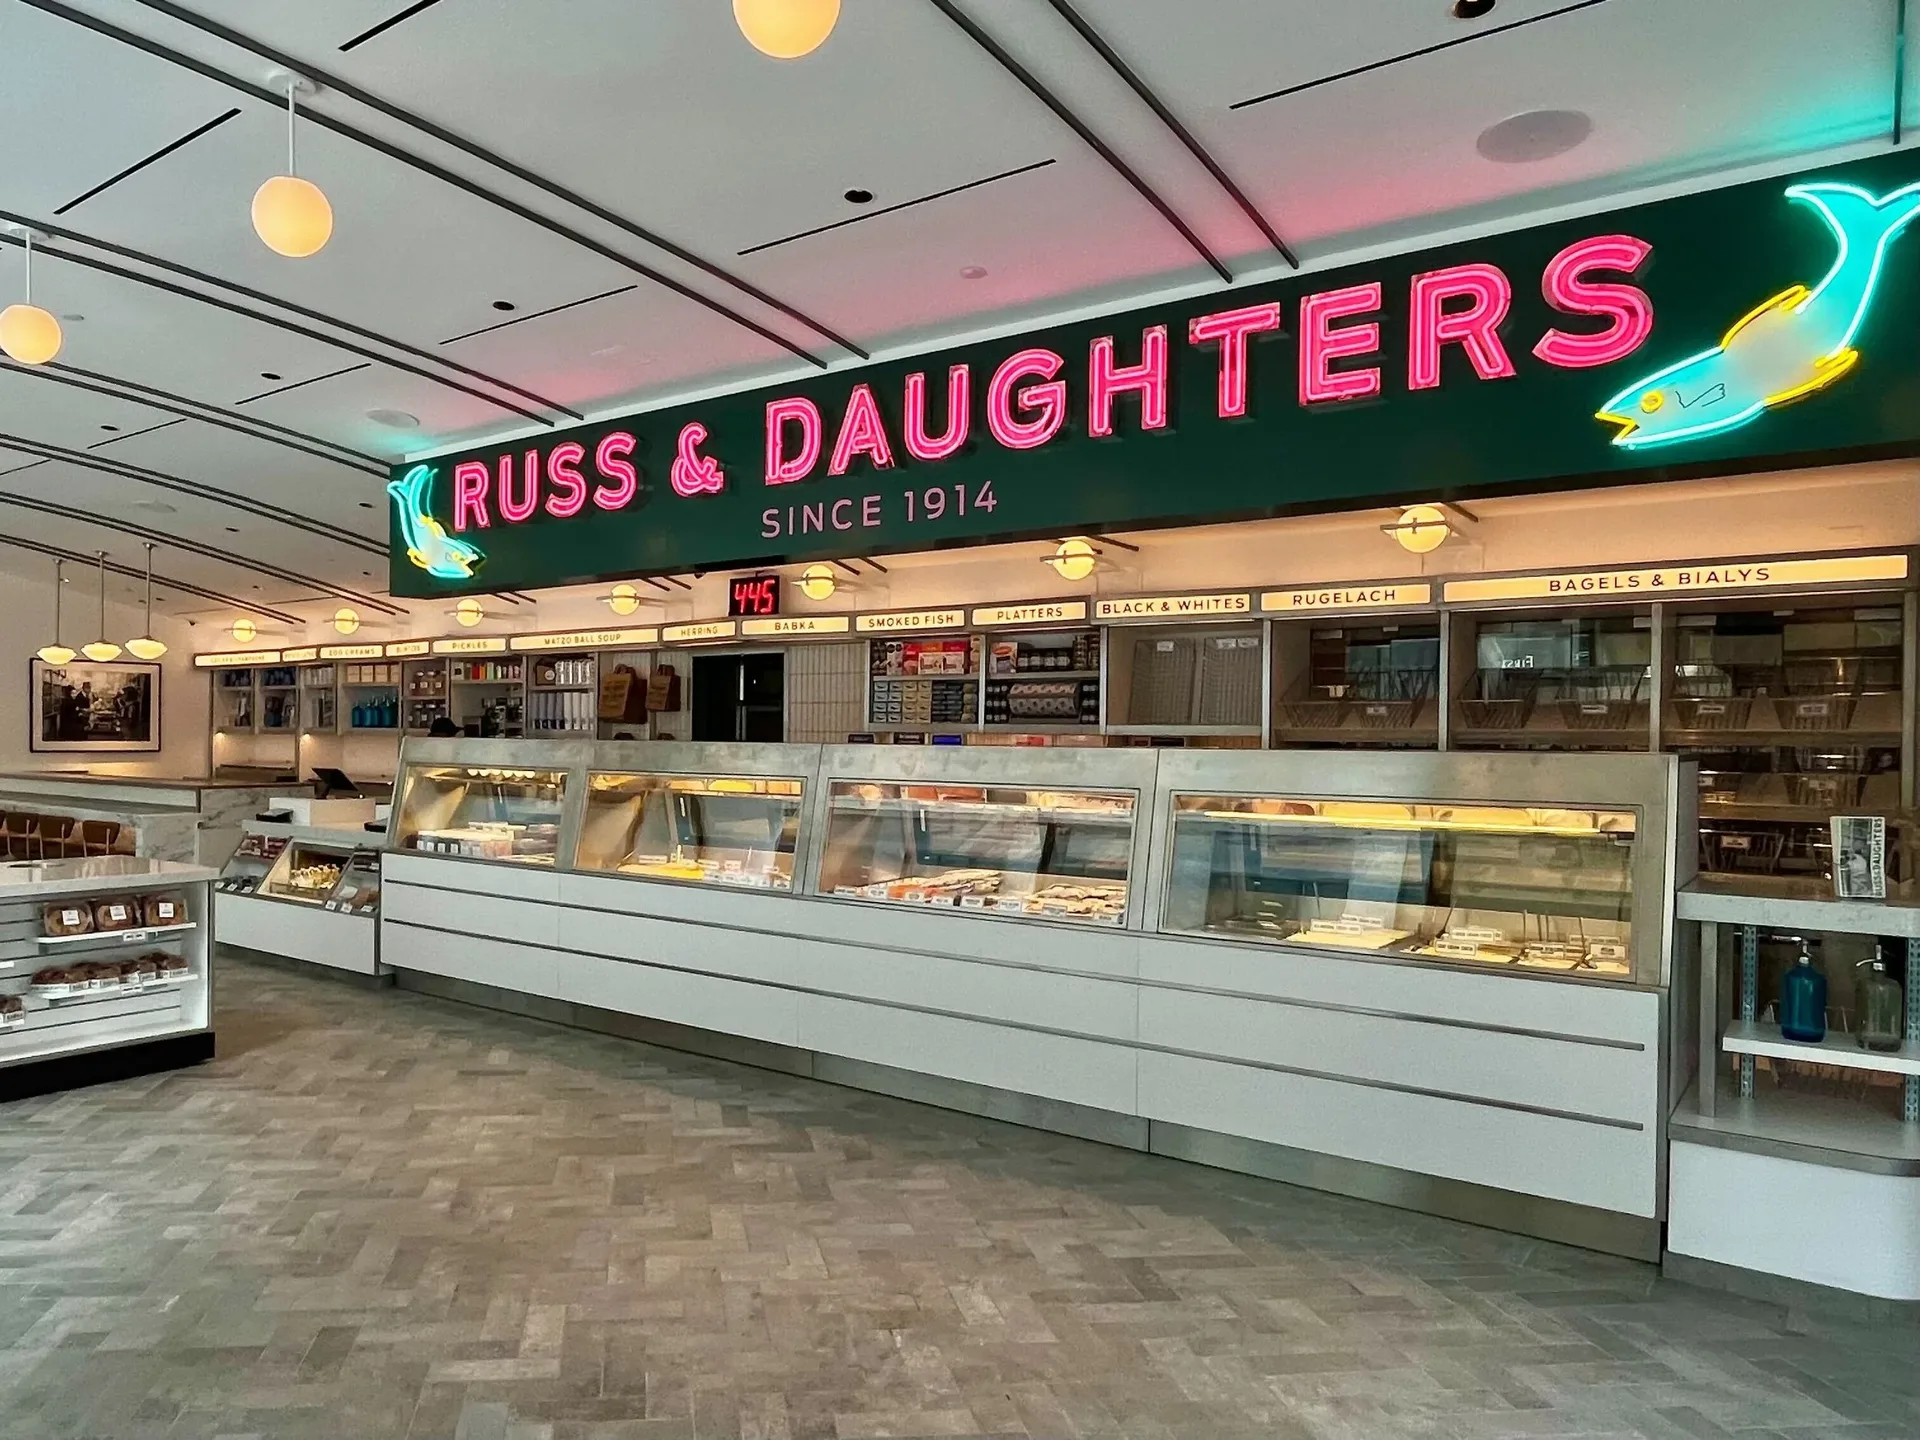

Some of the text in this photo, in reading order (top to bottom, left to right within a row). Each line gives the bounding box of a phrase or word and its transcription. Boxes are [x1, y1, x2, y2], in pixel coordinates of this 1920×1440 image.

[453, 234, 1655, 533] RUSS & DAUGHTERS
[760, 480, 999, 540] SINCE 1914
[1549, 567, 1770, 592] BAGELS & BIALYS
[734, 578, 776, 614] 445
[1292, 588, 1396, 606] RUGELACH
[997, 606, 1064, 621] PLATTERS
[1102, 597, 1246, 615] BLACK & WHITES
[774, 619, 816, 631] BABKA
[868, 613, 955, 629] SMOKED FISH
[544, 632, 622, 646] MATZO BALL SOUP
[680, 625, 719, 637] HERRING
[452, 640, 489, 650] PICKLES
